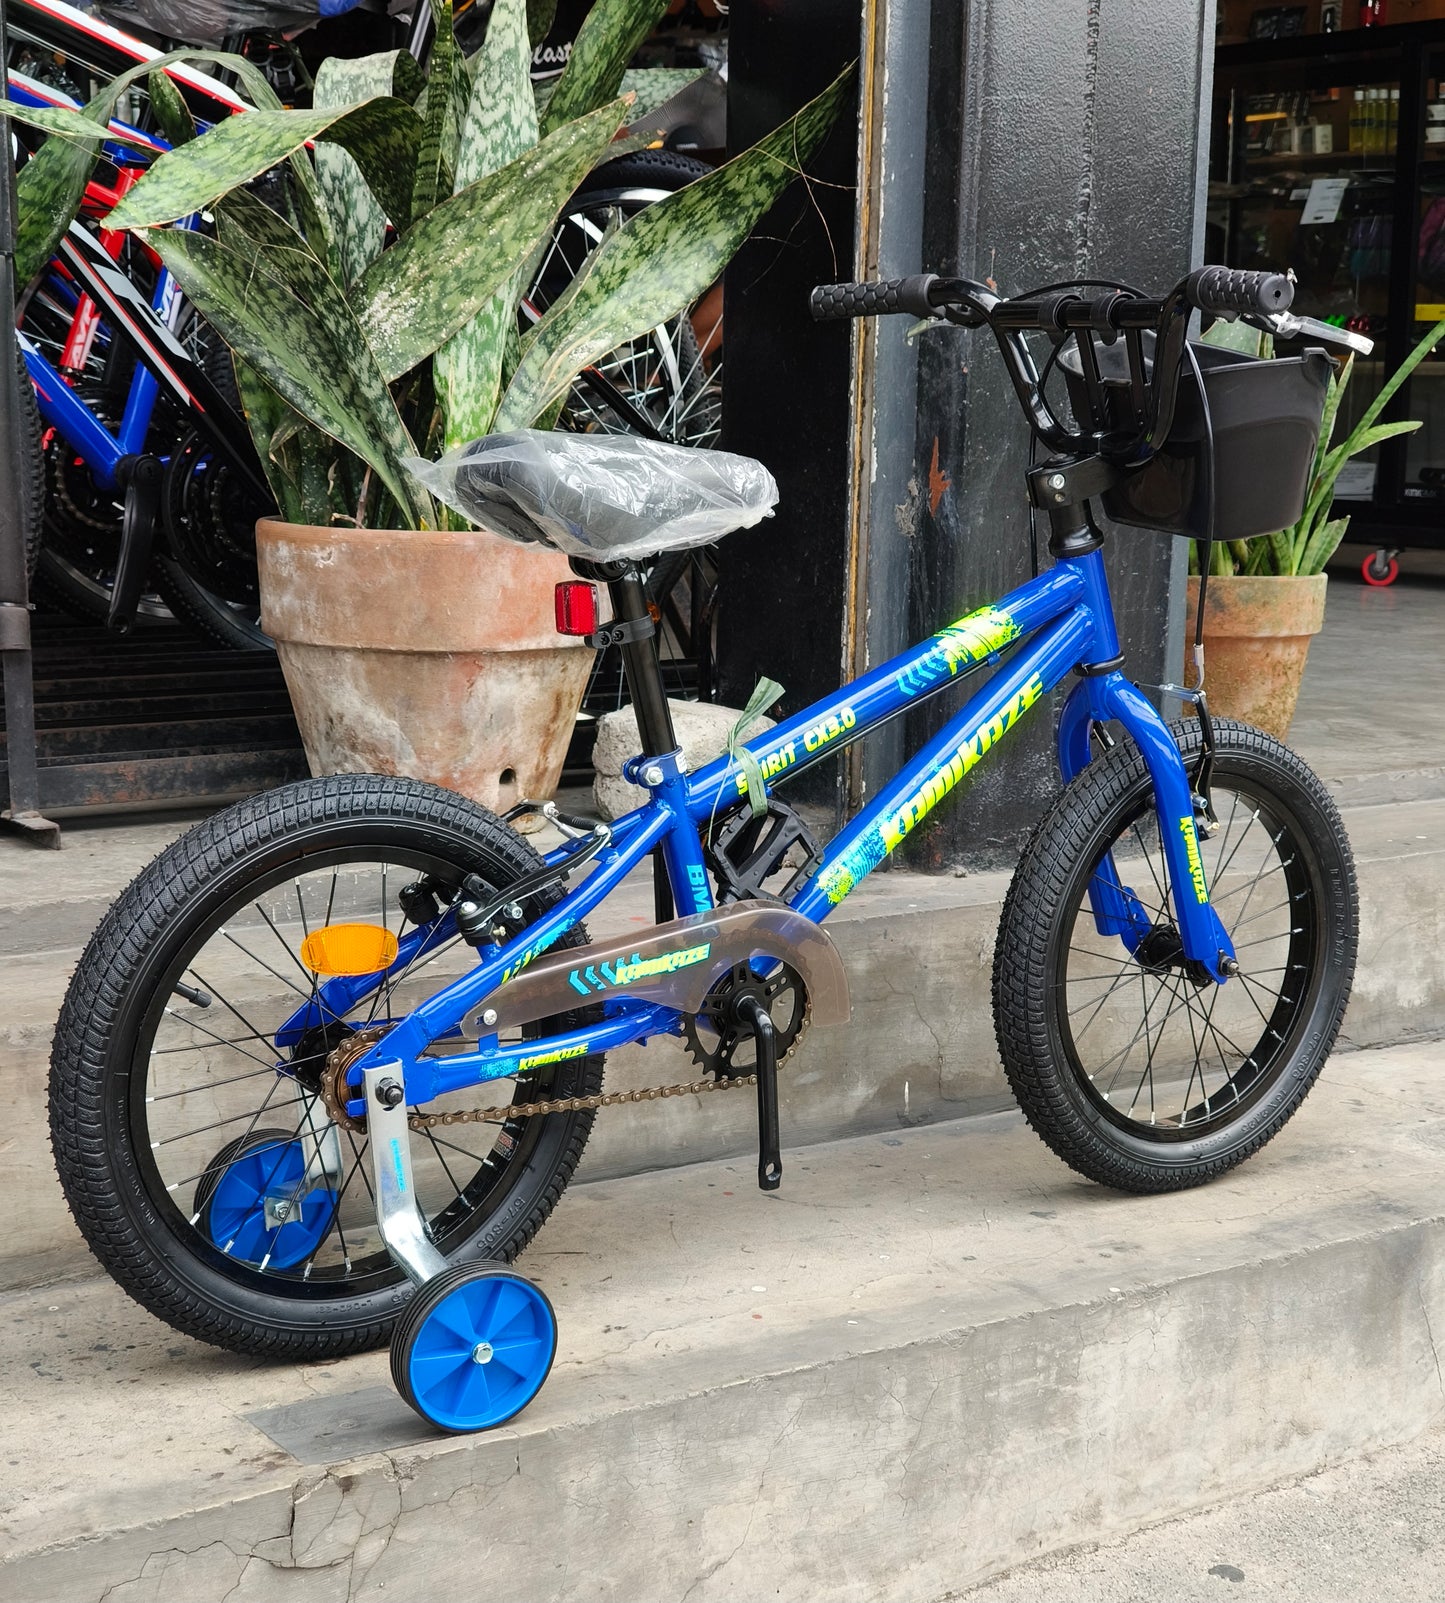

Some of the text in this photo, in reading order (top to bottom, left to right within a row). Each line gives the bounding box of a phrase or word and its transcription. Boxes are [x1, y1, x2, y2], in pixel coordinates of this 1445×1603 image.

[735, 707, 857, 796] SIRIT CX3.0
[880, 671, 1044, 856] KAMIKAZE
[1179, 815, 1209, 905] KAMIKAZE
[615, 943, 711, 985] KAMIKAZE
[518, 1043, 590, 1072] KAMIKAZE
